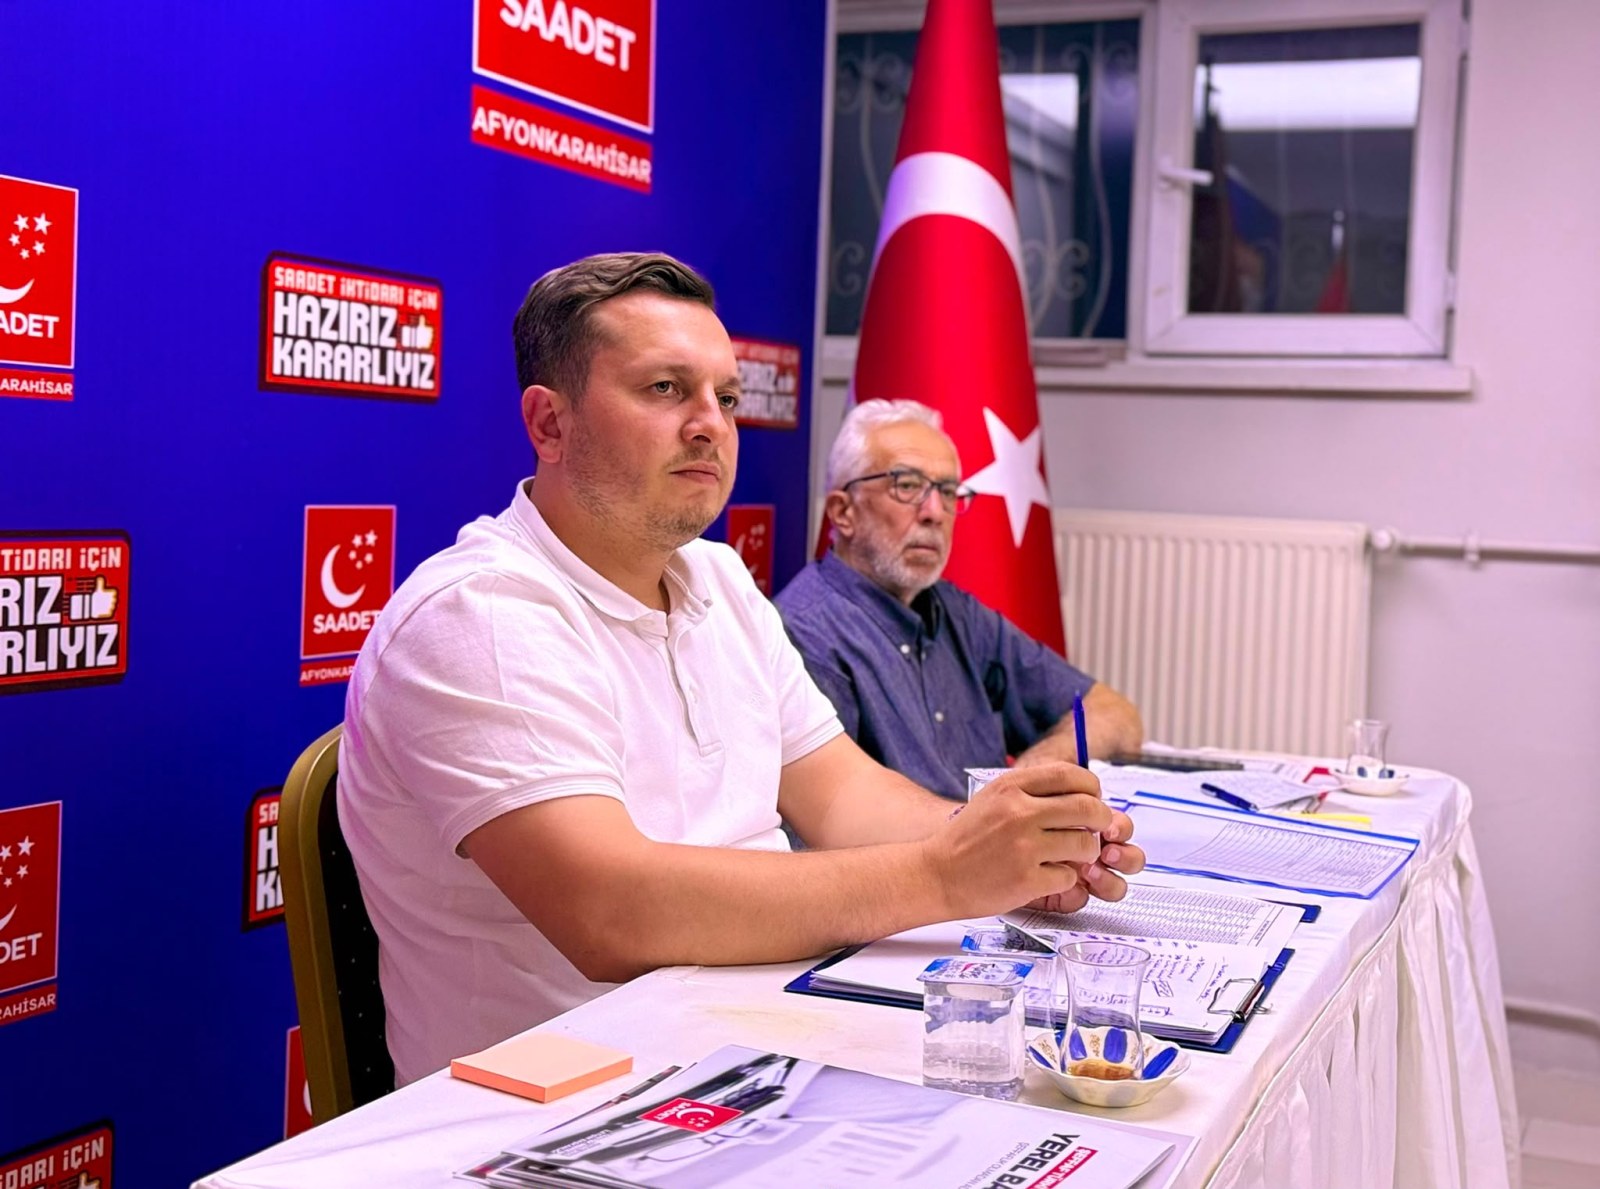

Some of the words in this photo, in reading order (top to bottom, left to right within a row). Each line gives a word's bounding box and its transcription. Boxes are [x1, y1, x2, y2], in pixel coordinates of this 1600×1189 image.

[472, 106, 652, 183] AFYONKARAHİSAR
[274, 266, 336, 294] SAADET
[273, 290, 398, 348] HAZIRIZ
[272, 336, 436, 390] KARARLIYIZ
[0, 993, 56, 1020] AHİSAR
[1008, 1133, 1080, 1172] YEREL
